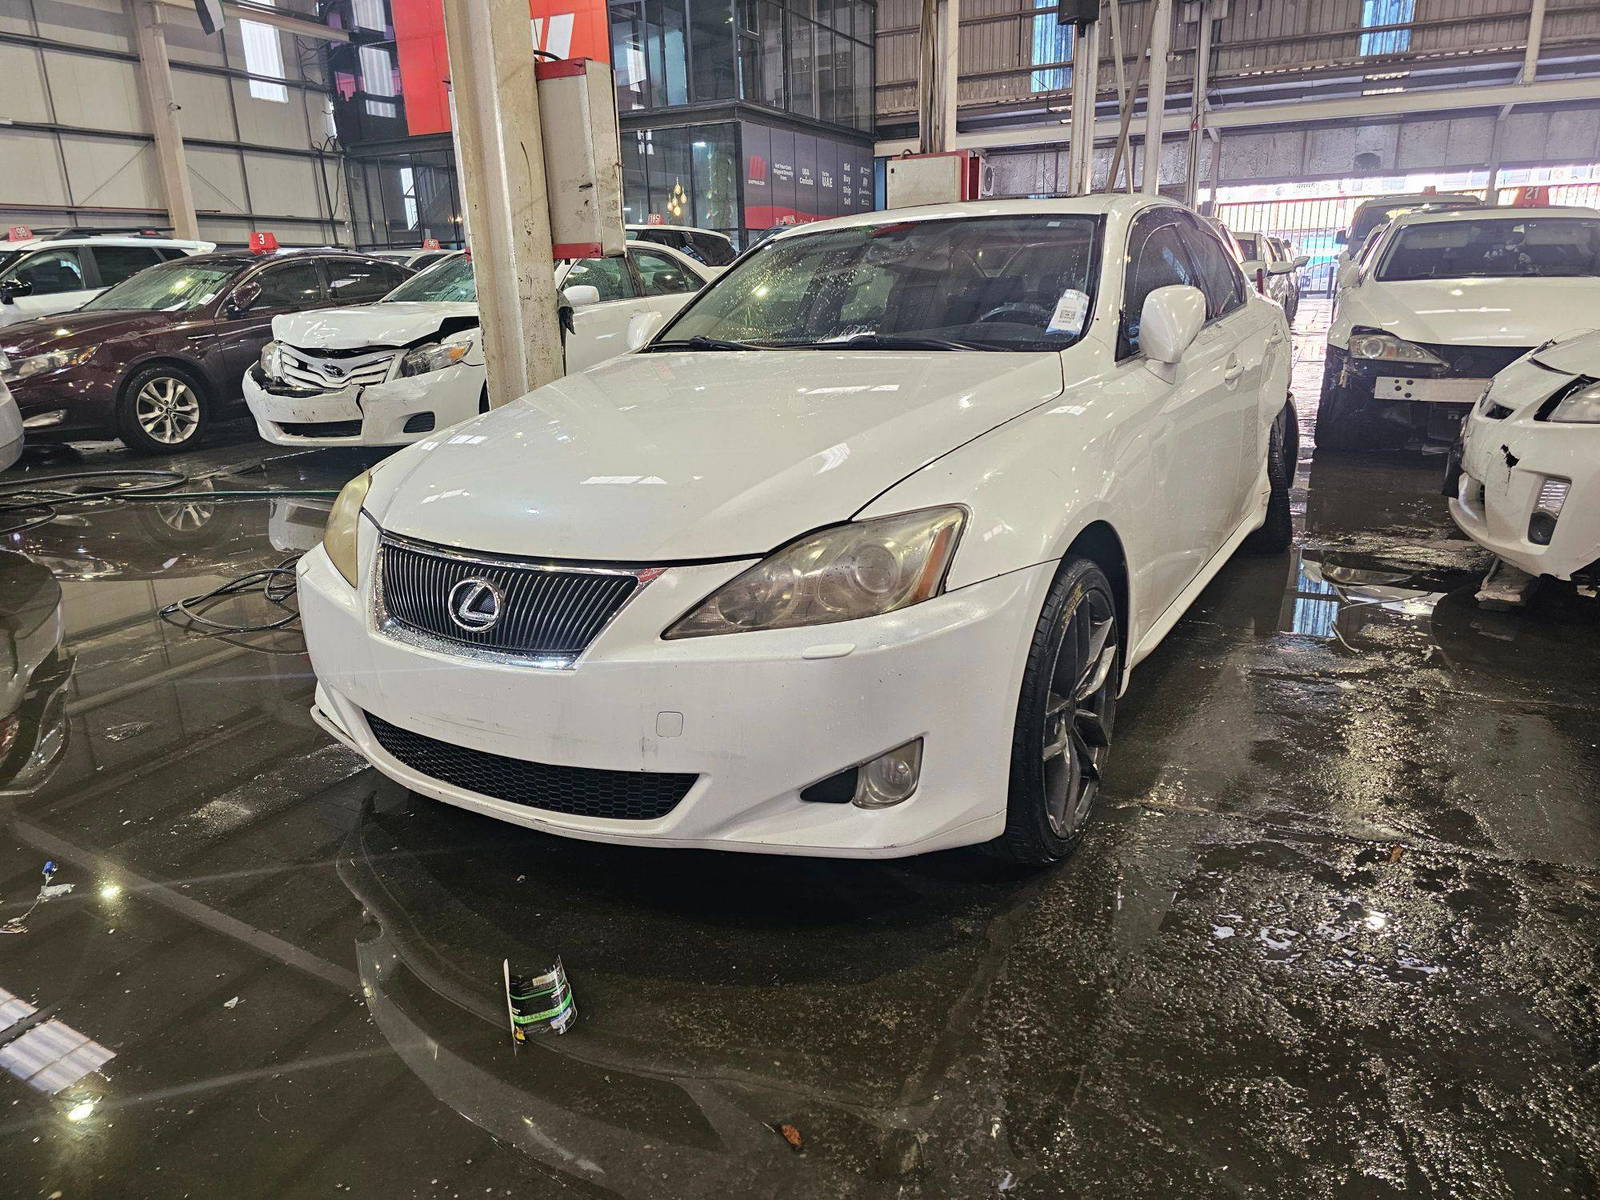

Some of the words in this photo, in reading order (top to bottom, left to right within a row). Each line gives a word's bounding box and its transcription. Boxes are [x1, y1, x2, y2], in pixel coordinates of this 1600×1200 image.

[822, 176, 832, 187] UAE
[1525, 187, 1539, 200] 21
[258, 233, 265, 245] 3
